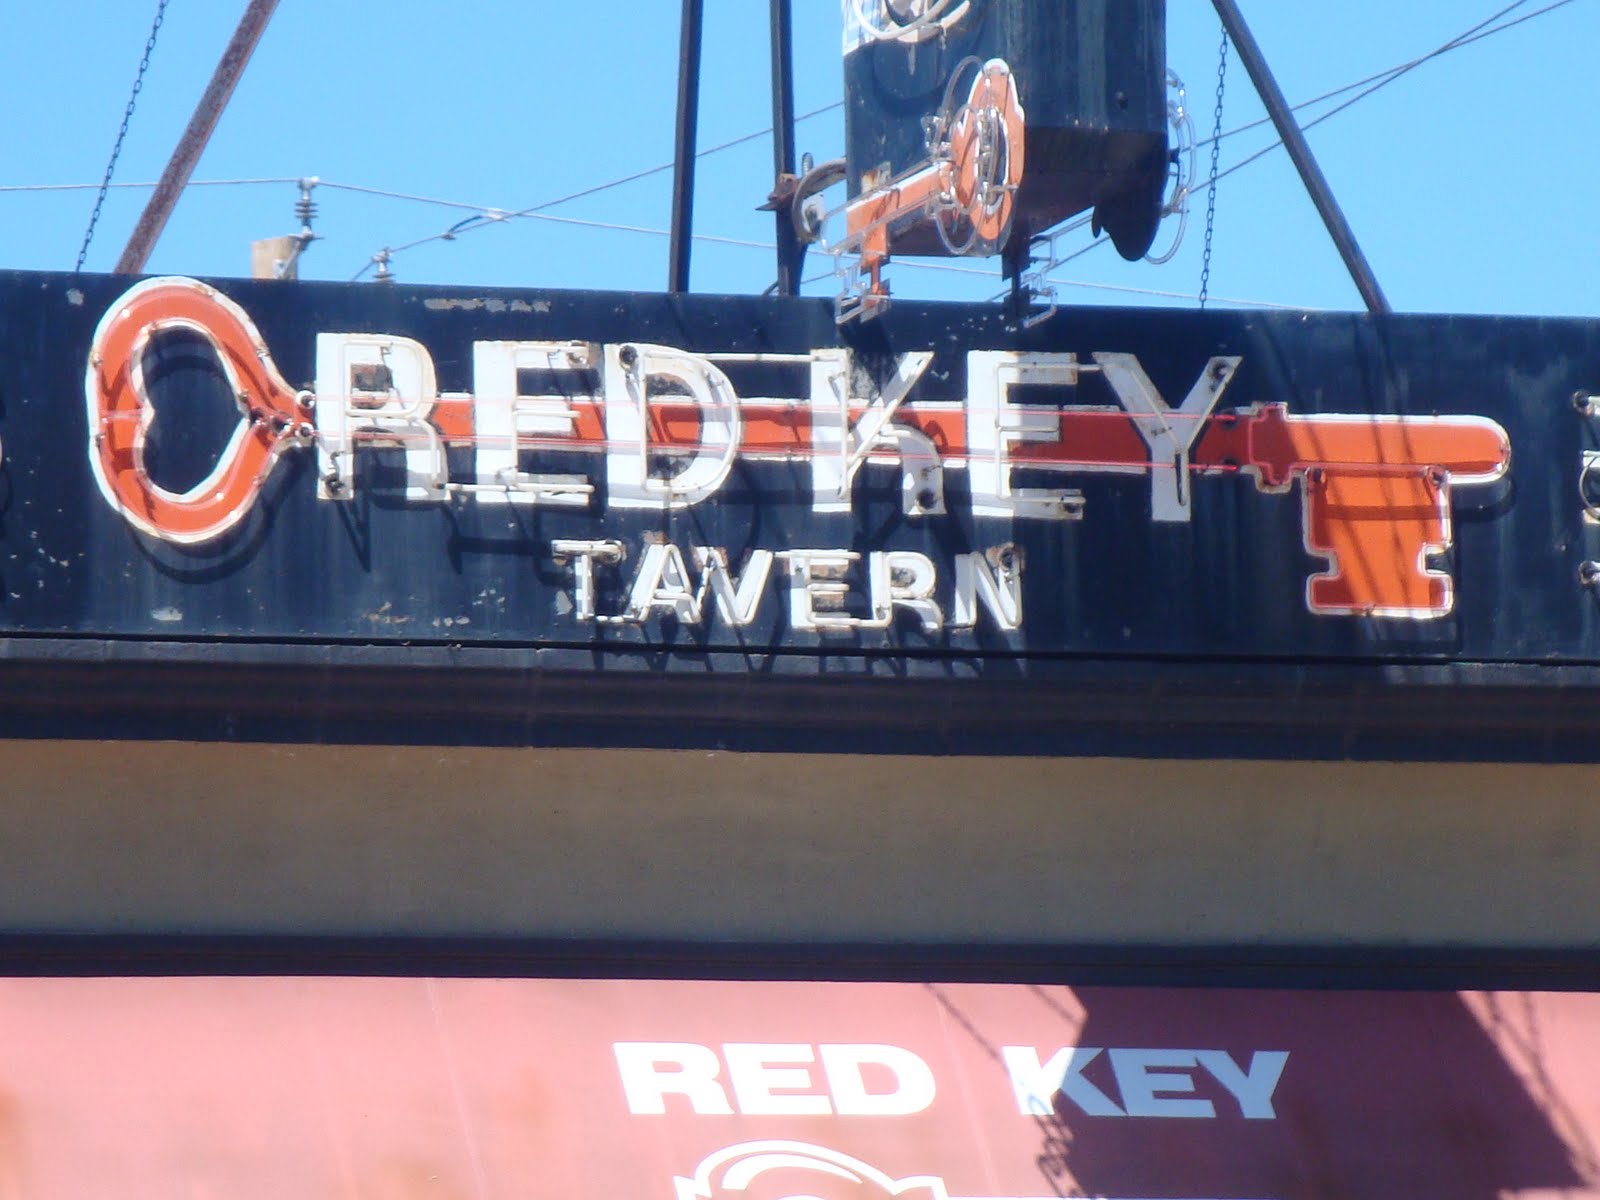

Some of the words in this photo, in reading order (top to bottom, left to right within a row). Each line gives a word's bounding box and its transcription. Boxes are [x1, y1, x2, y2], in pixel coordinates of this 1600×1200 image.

[316, 332, 747, 509] RED
[810, 347, 1242, 522] KEY
[551, 537, 1025, 631] TAVERN
[612, 1041, 936, 1116] RED
[1000, 1045, 1291, 1120] KEY
